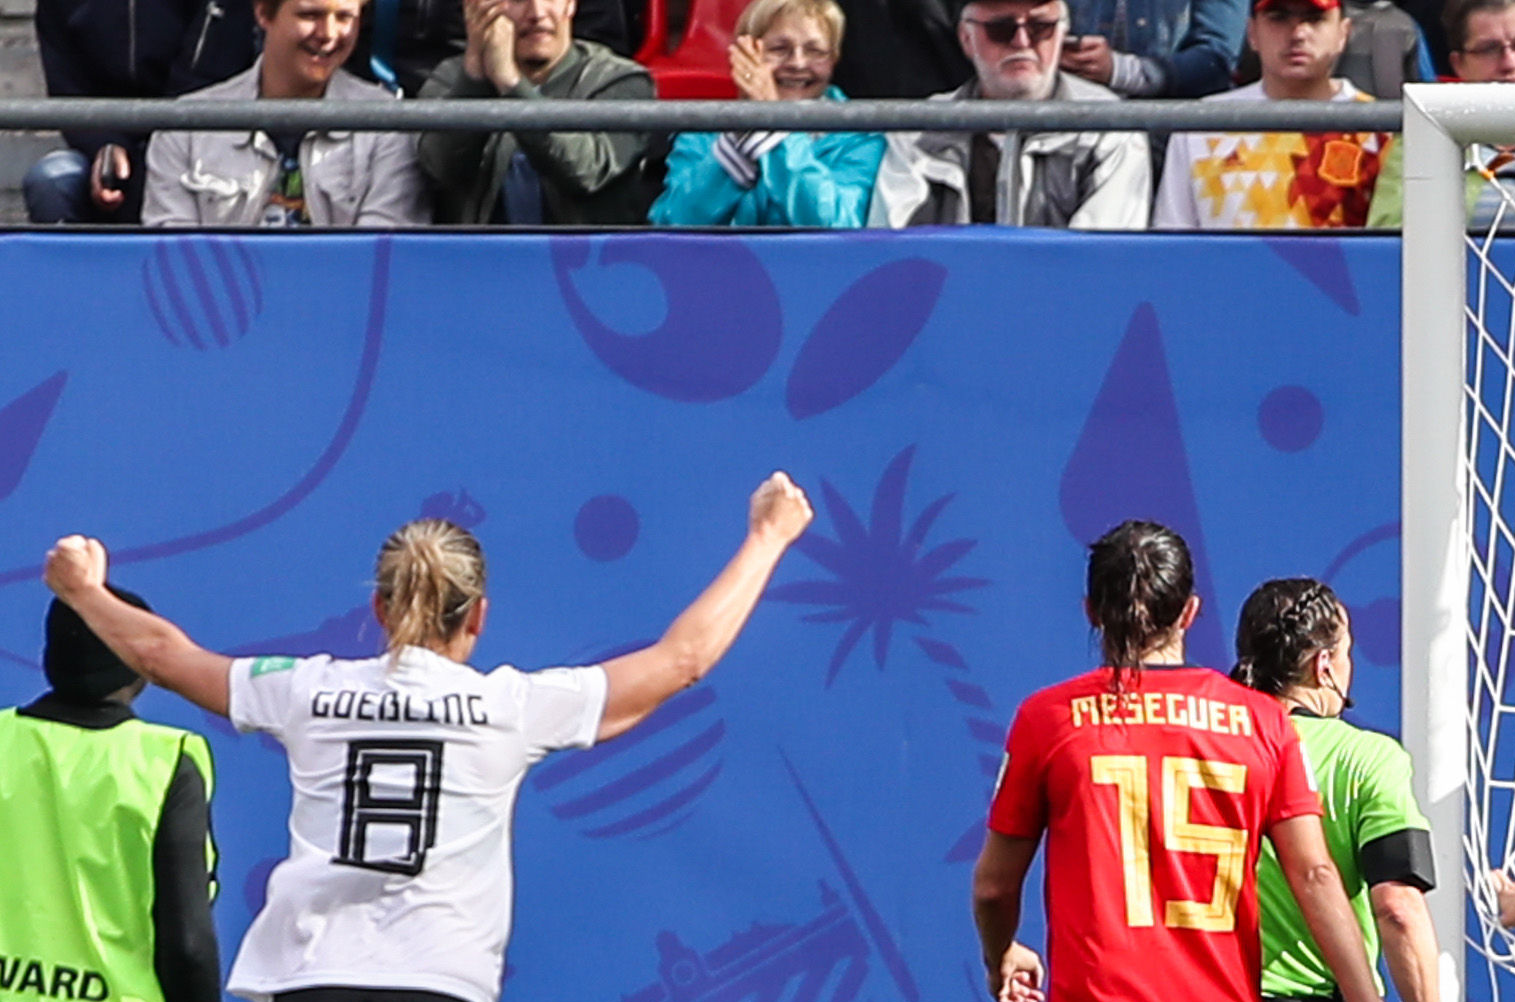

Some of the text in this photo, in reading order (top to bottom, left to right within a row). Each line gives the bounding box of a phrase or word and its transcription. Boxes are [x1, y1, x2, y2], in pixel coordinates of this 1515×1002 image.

[1071, 692, 1252, 737] MESEGUER
[331, 738, 443, 876] 8
[1090, 755, 1249, 932] 15
